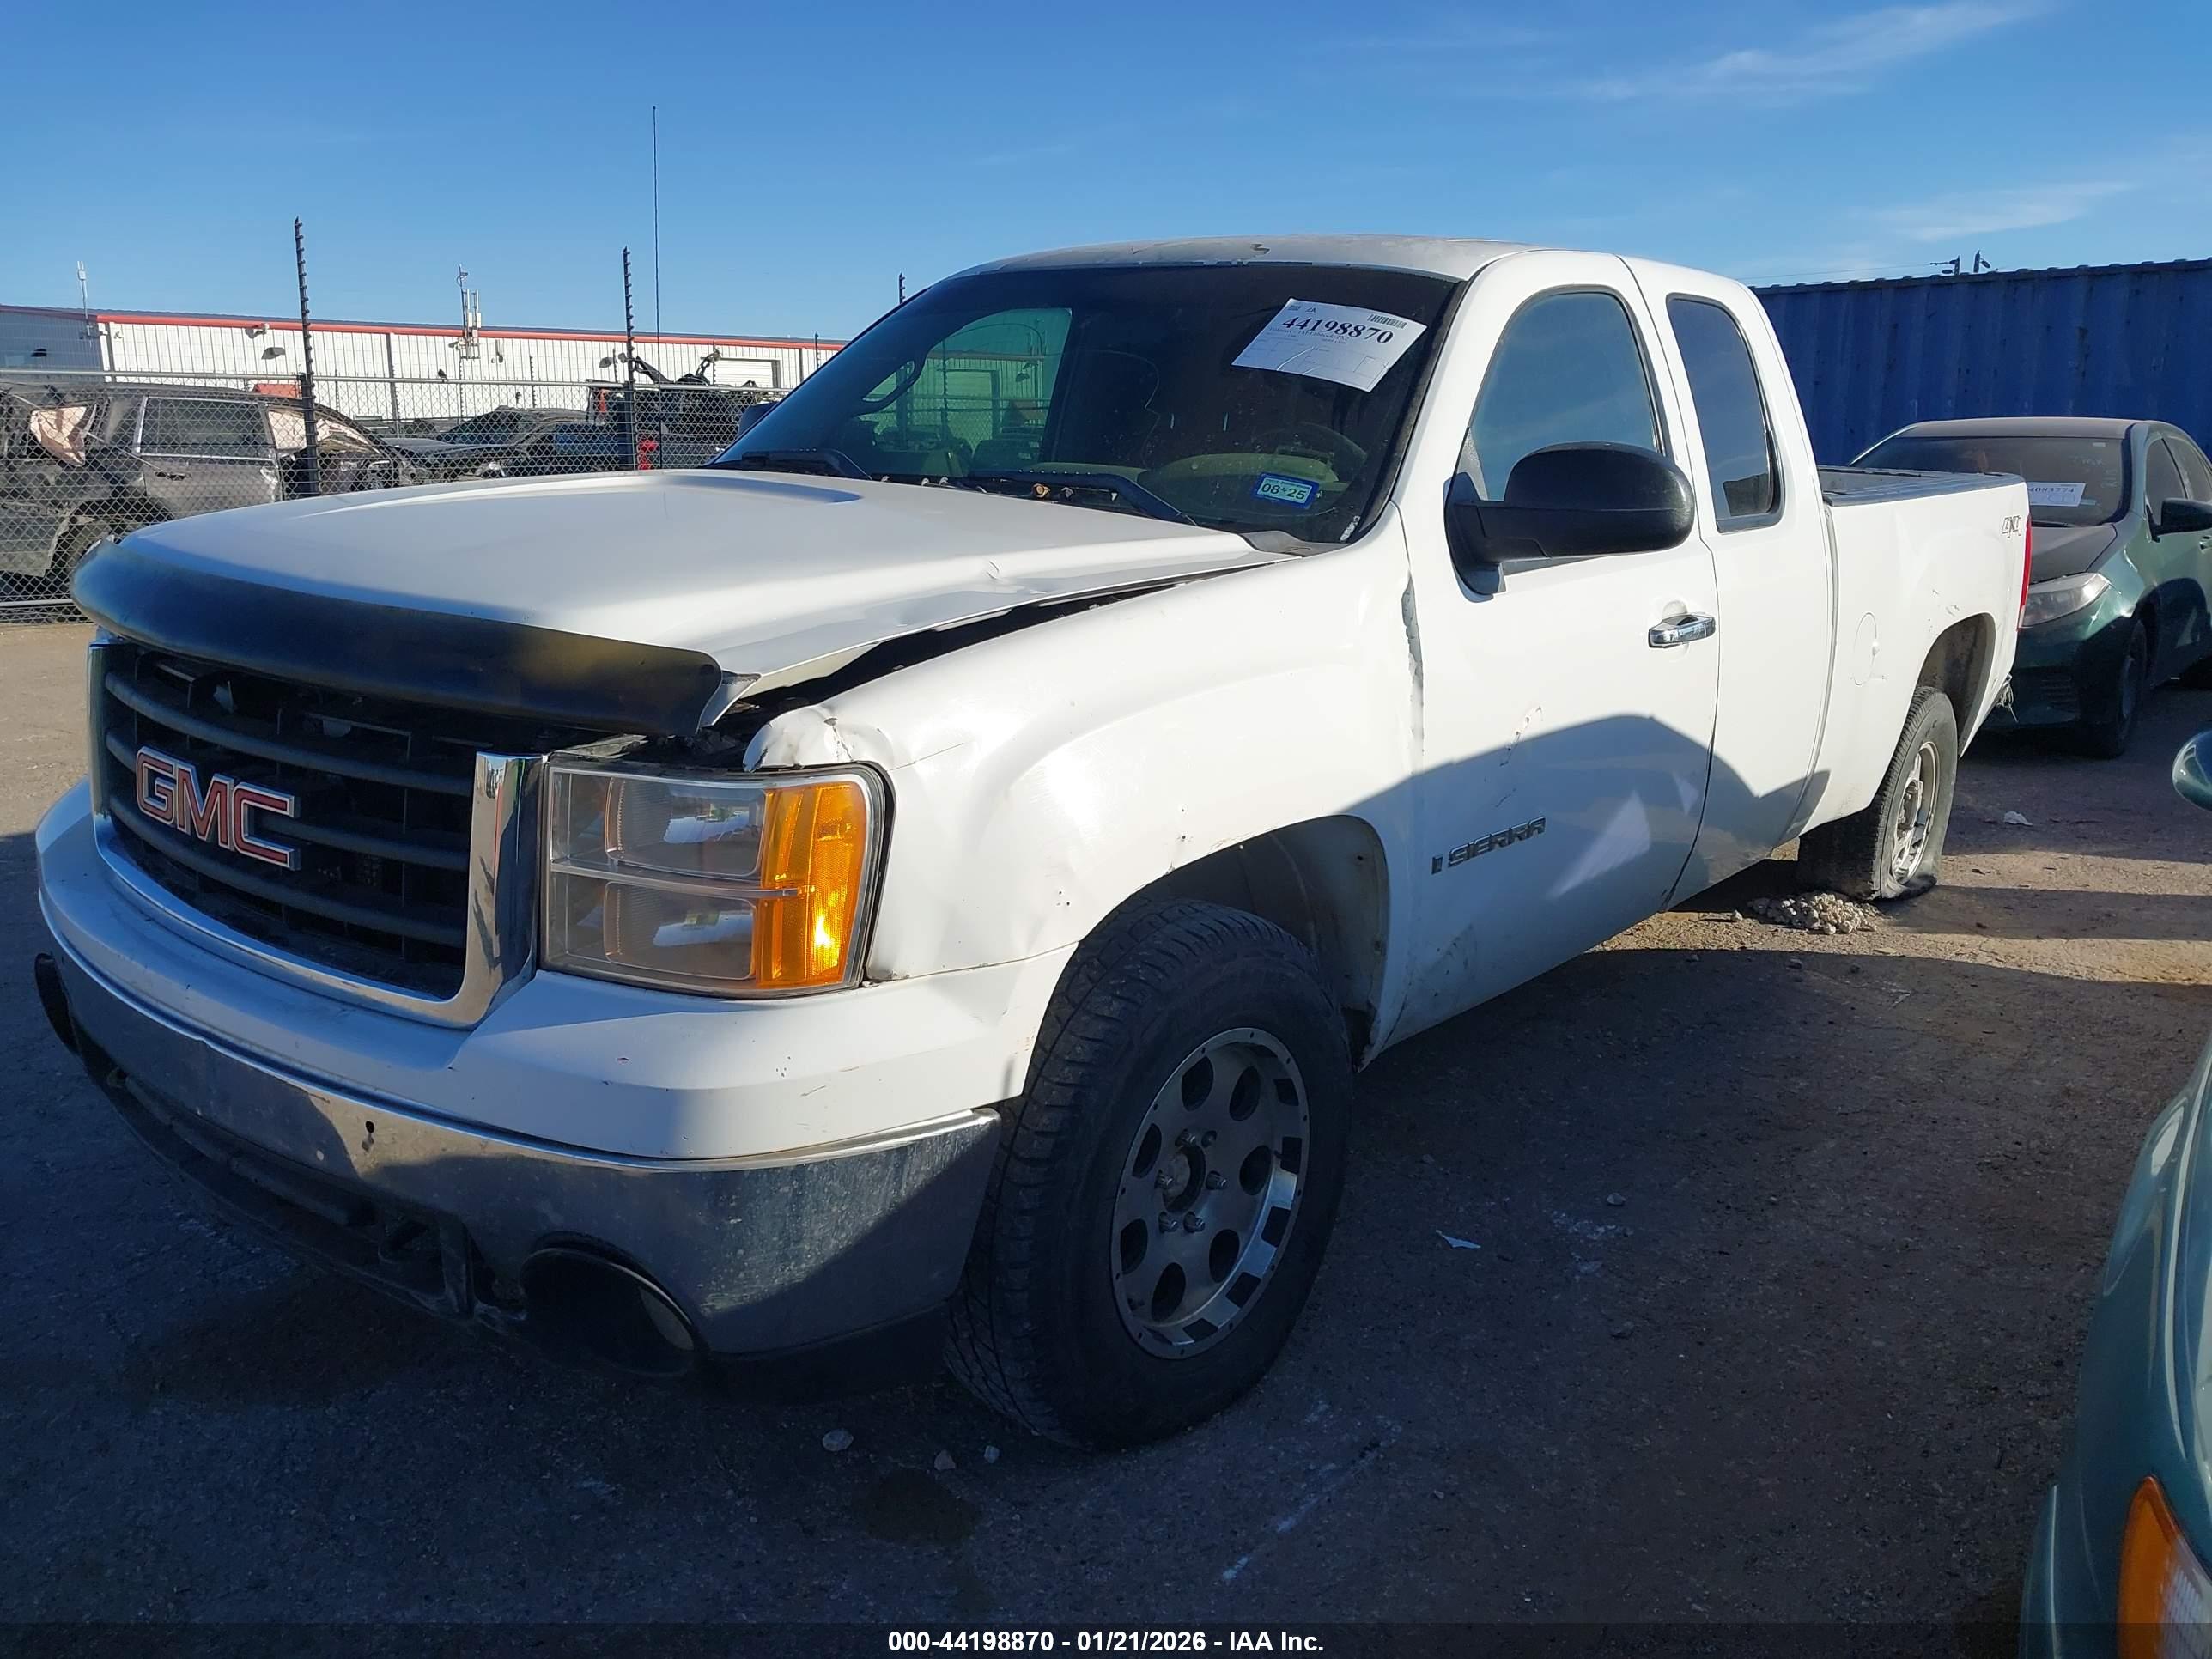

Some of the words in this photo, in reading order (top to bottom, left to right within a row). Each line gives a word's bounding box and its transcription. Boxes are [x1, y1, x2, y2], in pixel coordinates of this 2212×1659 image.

[1283, 317, 1394, 343] 44198870
[1261, 483, 1280, 495] 08
[1287, 488, 1306, 499] 25
[137, 746, 298, 870] GMC
[1448, 816, 1546, 868] SIERRA
